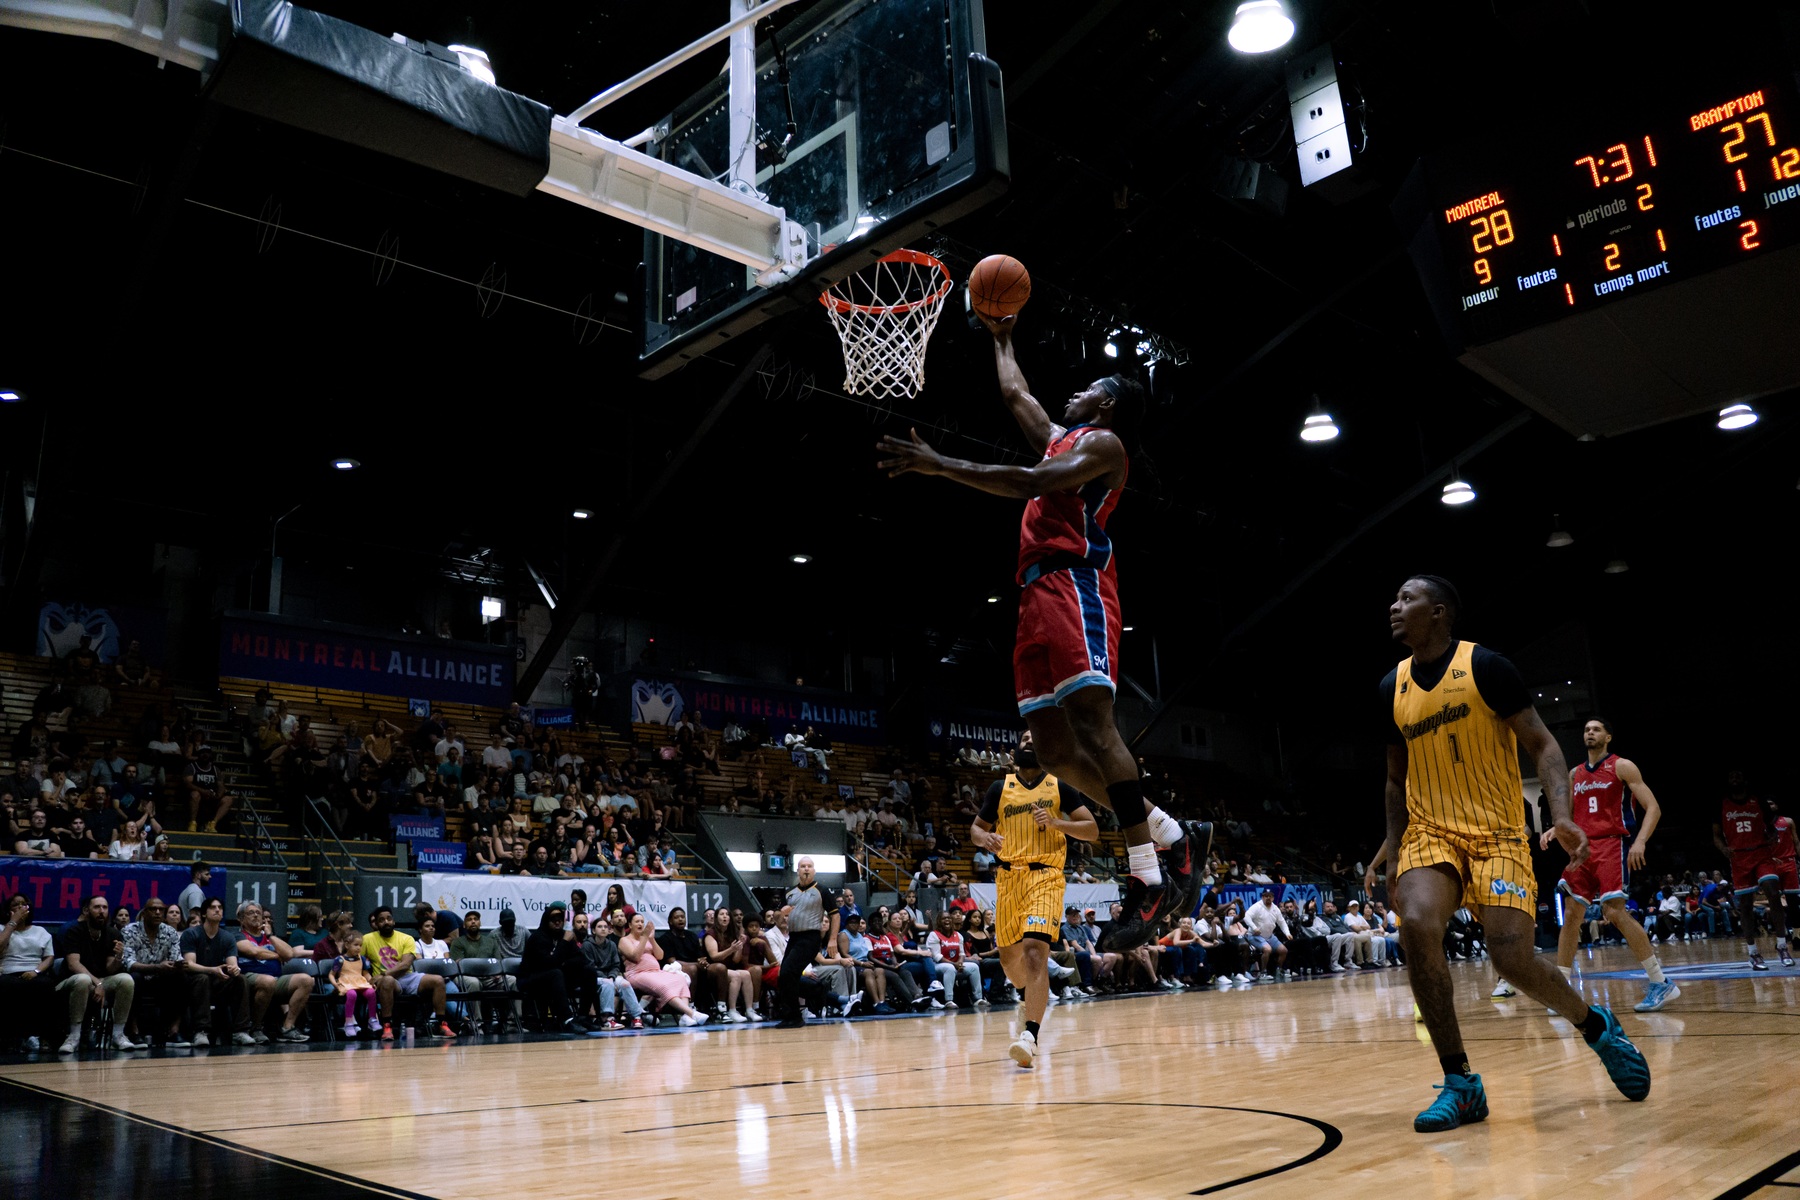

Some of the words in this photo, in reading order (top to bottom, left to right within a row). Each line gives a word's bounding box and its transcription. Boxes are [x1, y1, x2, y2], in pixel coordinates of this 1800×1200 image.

[1690, 90, 1765, 131] BRAMPTON
[1720, 111, 1776, 164] 27
[1574, 135, 1657, 187] 7:31
[1770, 147, 1800, 181] 12
[1736, 168, 1746, 192] 1
[1445, 191, 1505, 224] MONTREAL
[1636, 183, 1654, 211] 2
[1578, 199, 1628, 229] période
[1694, 205, 1742, 231] fautes
[1470, 209, 1515, 253] 28
[1656, 229, 1667, 251] 1
[1739, 219, 1760, 250] 2
[1553, 234, 1562, 256] 1
[1603, 243, 1621, 271] 2
[1473, 258, 1492, 285] 9
[1517, 268, 1558, 291] fautes
[1594, 273, 1634, 297] temps
[1637, 260, 1670, 283] mort
[1462, 286, 1500, 311] joueur
[1565, 282, 1574, 305] 1
[387, 650, 503, 687] ALLIANCE
[1443, 686, 1467, 694] Sheridan
[536, 714, 573, 725] ALLIANCE
[801, 701, 879, 728] ALLIANCE
[1448, 733, 1464, 764] 1
[197, 773, 216, 783] NETS
[1589, 796, 1598, 813] 9
[396, 825, 440, 838] ALLIANCE
[1735, 820, 1752, 833] 25
[418, 851, 463, 864] ALLIANCE
[234, 880, 277, 905] 111
[375, 886, 418, 909] 112
[460, 896, 486, 910] Sun
[489, 897, 512, 910] Life
[691, 893, 724, 912] 112
[522, 898, 549, 911] Votr
[636, 900, 646, 912] la
[649, 901, 667, 913] vie
